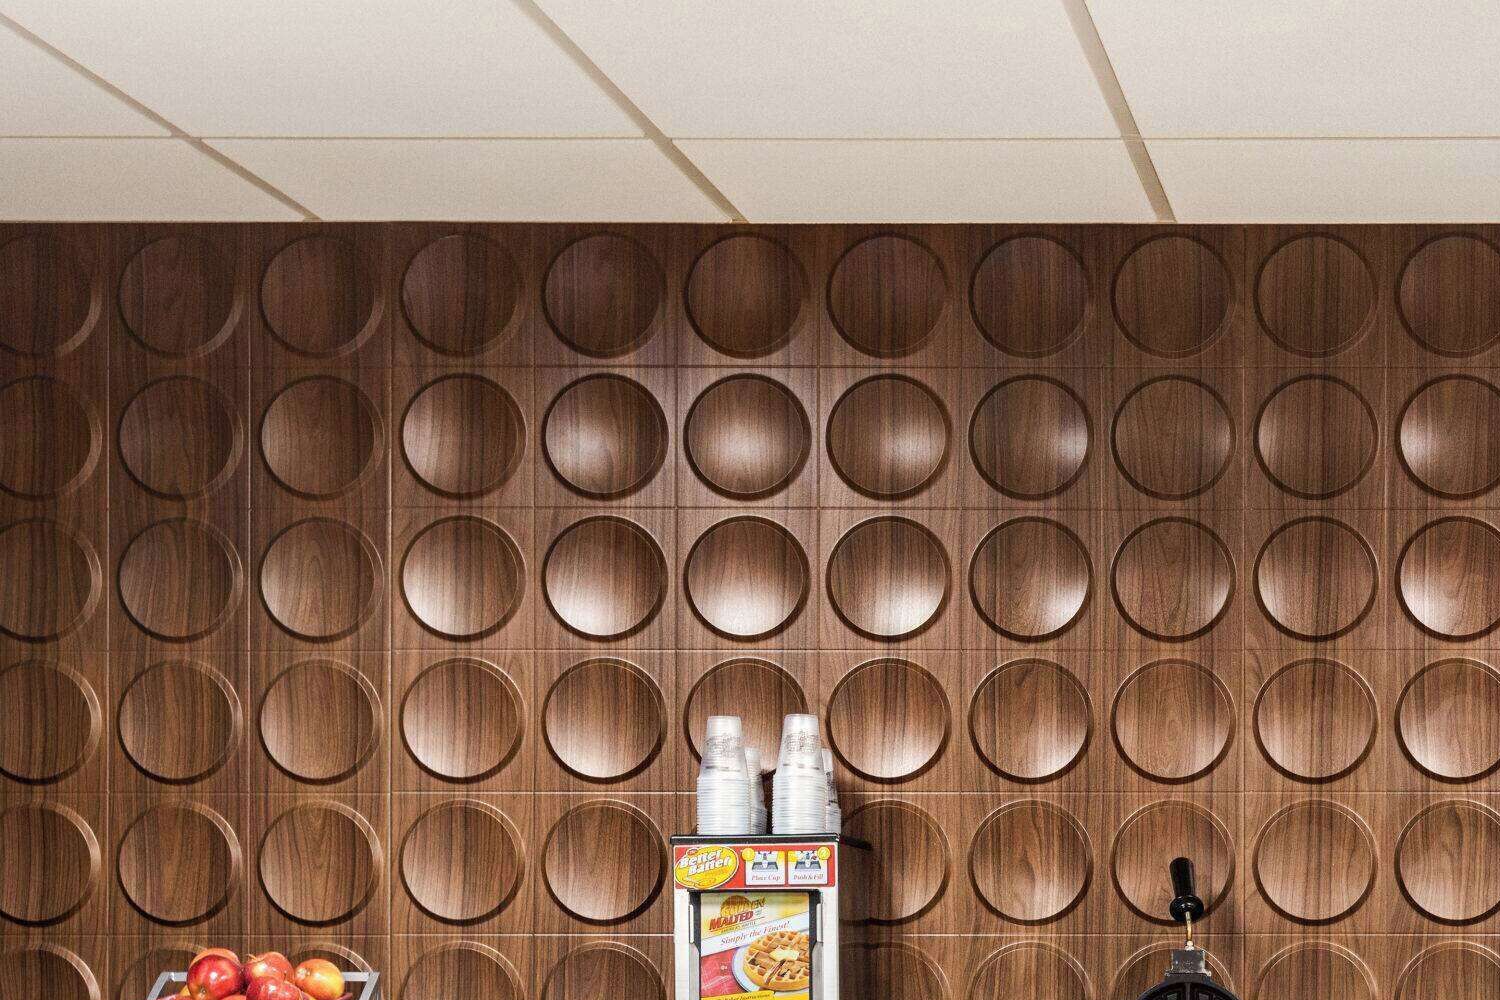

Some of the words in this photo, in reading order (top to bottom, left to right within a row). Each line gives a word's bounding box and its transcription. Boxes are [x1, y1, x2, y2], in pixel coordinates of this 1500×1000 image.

[768, 874, 781, 882] Cup
[709, 911, 753, 930] MALTED
[721, 932, 748, 945] Simply
[749, 930, 760, 938] the
[763, 921, 790, 934] Finest!
